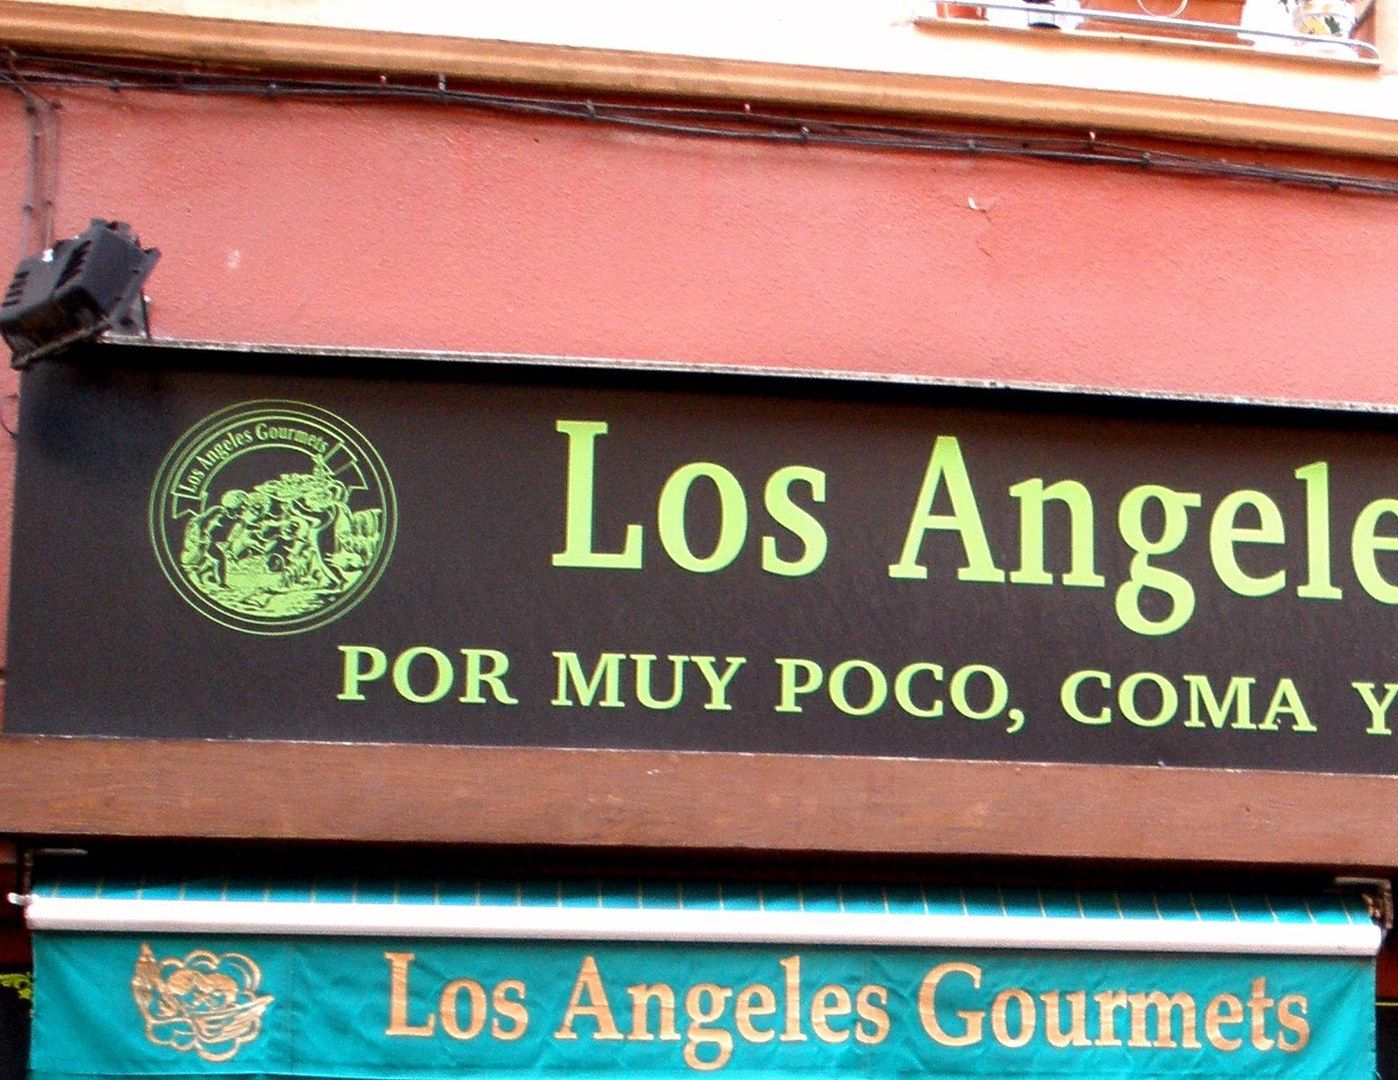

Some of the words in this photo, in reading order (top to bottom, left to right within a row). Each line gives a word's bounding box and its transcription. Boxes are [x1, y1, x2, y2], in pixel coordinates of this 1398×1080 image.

[178, 468, 205, 494] Los
[197, 428, 254, 473] Angeles
[255, 422, 330, 454] Gourmets
[551, 420, 828, 577] Los
[338, 645, 517, 705] POR
[552, 651, 746, 711] MUY
[776, 658, 1025, 733] POCO,
[1060, 669, 1317, 732] COMA
[384, 952, 528, 1040] Los
[555, 955, 889, 1071] Angeles
[918, 961, 1310, 1052] Gourmets
